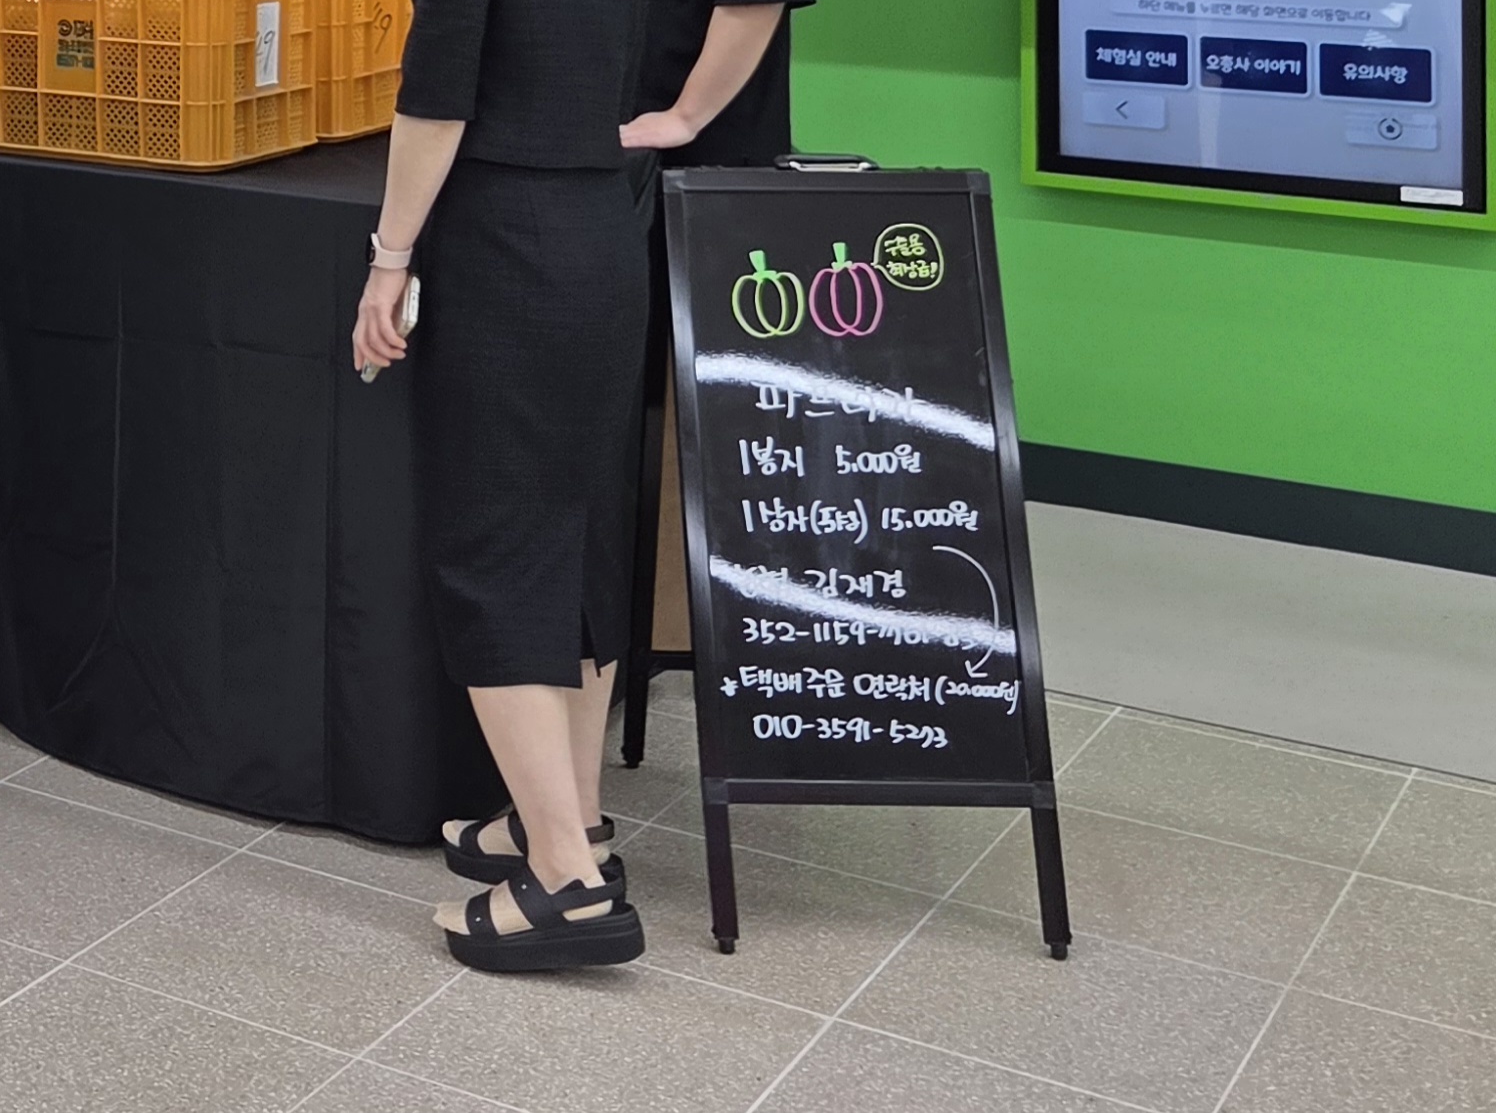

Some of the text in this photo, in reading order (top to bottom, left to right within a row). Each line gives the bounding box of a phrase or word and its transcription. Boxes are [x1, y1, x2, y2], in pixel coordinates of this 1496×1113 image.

[1095, 46, 1178, 68] 체험실 안내
[1253, 58, 1301, 77] 이야기
[1339, 61, 1409, 85] 유의사항
[803, 567, 907, 598] 김재경
